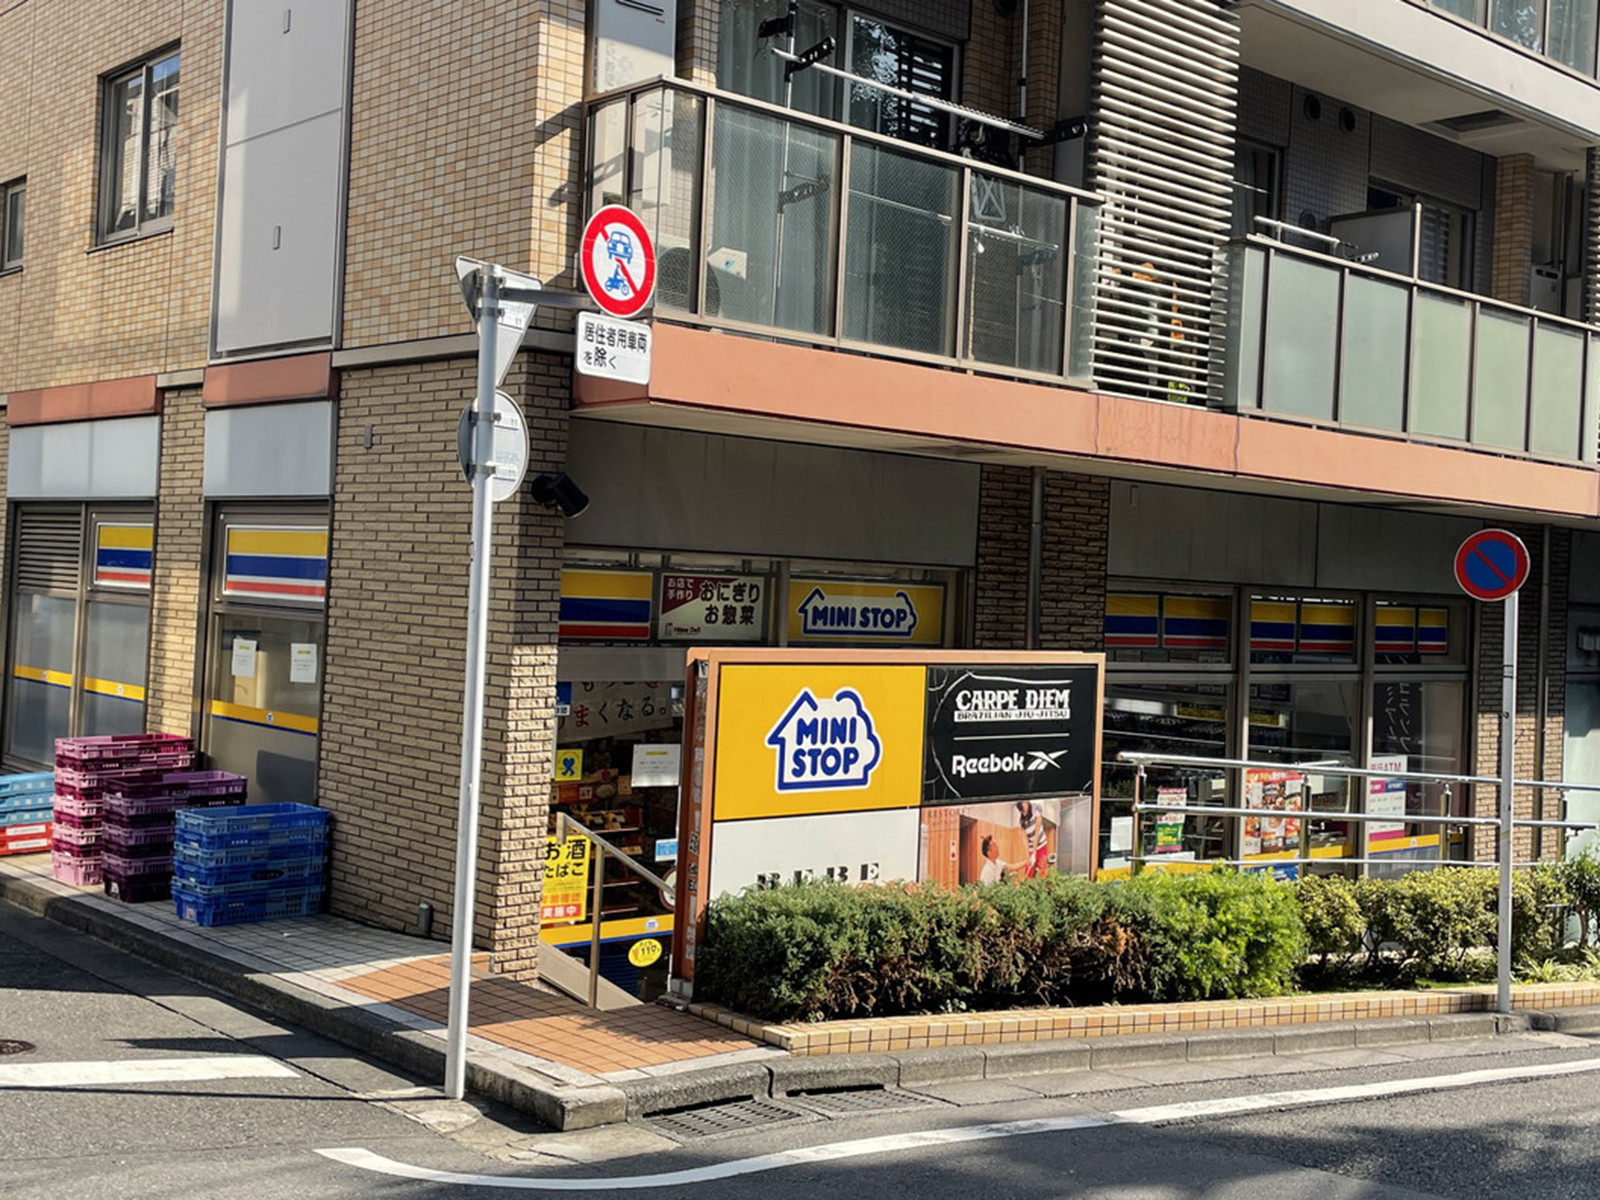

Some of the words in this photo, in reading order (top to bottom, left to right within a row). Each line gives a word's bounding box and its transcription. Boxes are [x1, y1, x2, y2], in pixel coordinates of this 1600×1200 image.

[585, 321, 648, 354] 居住者用車両
[583, 346, 617, 370] を除く
[700, 581, 760, 604] おにぎり
[704, 604, 755, 625] お惣菜
[811, 605, 857, 628] MINI
[859, 606, 908, 629] STOP
[956, 688, 1019, 711] CARPE
[1025, 688, 1071, 709] DIEM
[956, 711, 1012, 721] BRAZILIAN
[1015, 710, 1069, 719] JIU-JITSU
[796, 716, 858, 746] MINI
[791, 747, 860, 778] STOP
[952, 752, 1025, 778] Reebok
[543, 839, 587, 860] お酒
